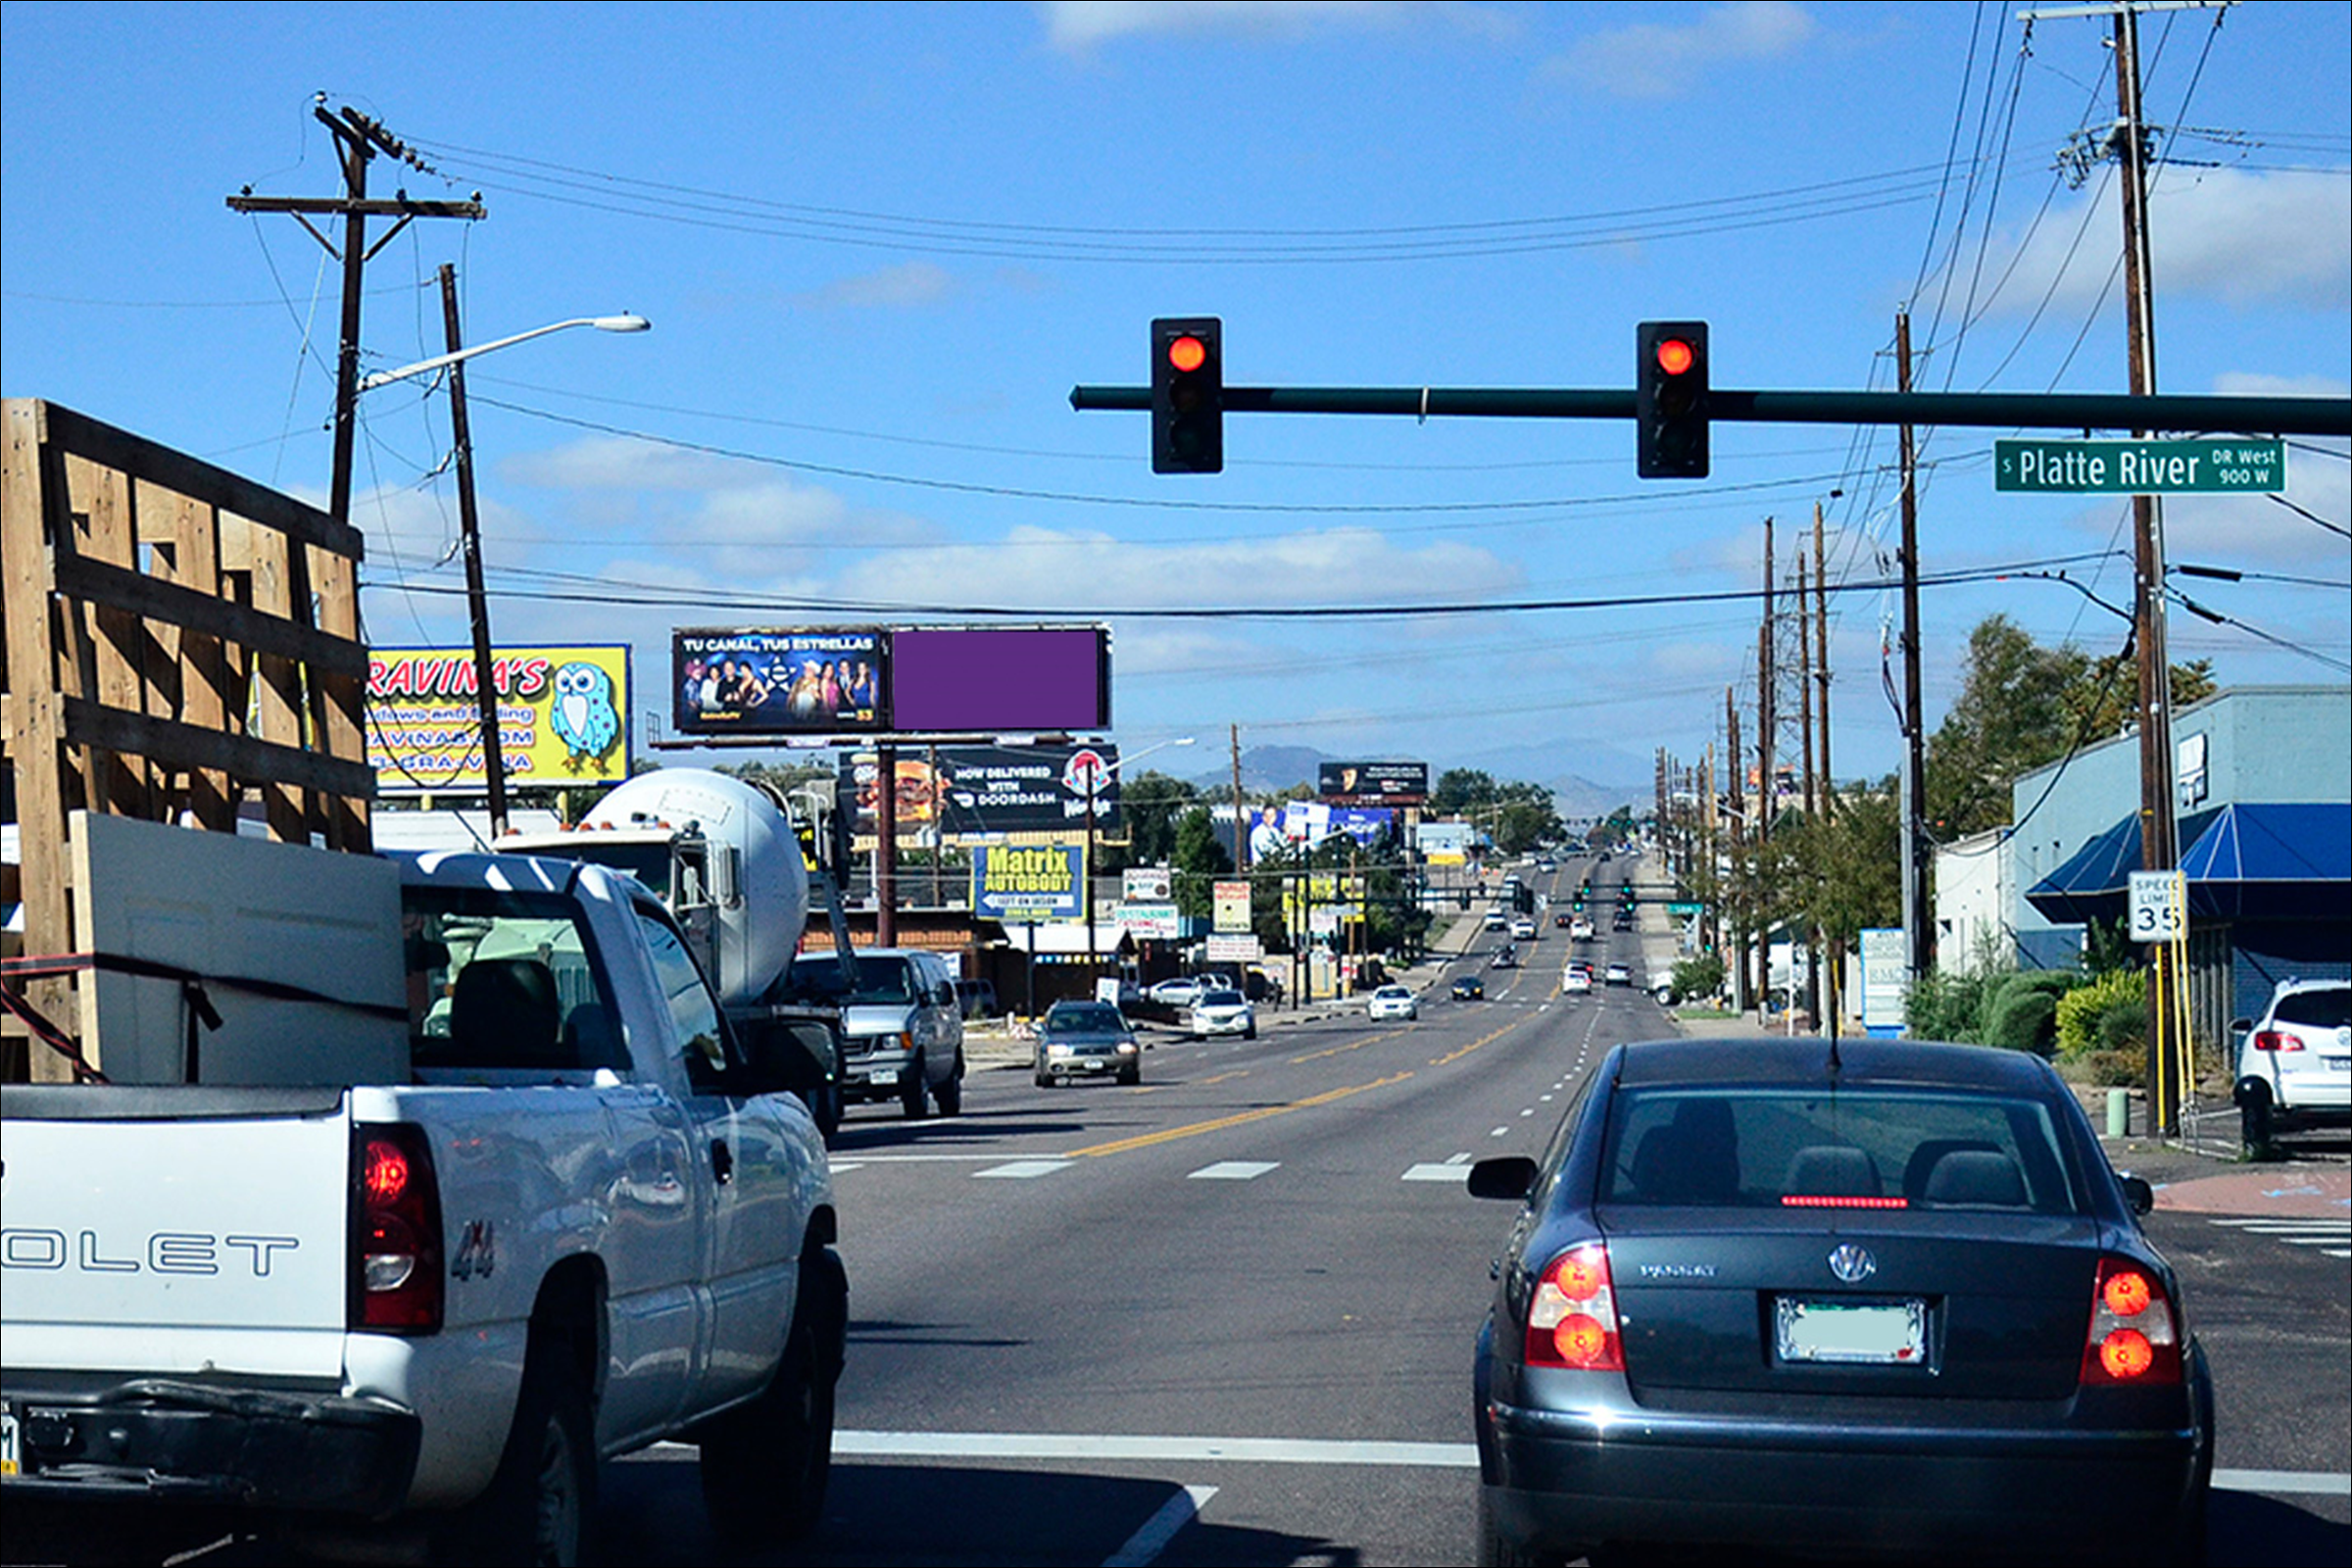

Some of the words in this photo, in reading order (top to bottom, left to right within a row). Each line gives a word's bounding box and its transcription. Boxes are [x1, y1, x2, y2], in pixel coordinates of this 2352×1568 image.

[2002, 458, 2012, 472] S
[2020, 449, 2105, 485] Platte
[2120, 448, 2199, 485] River
[2212, 450, 2232, 465] DR
[2238, 449, 2277, 464] West
[2220, 468, 2250, 484] 900
[2255, 468, 2270, 483] W
[683, 638, 703, 652] TU
[706, 638, 760, 653] CANAL,
[762, 638, 790, 651] TUS
[793, 637, 874, 651] ESTRELLAS
[365, 658, 550, 696] RAVINA'S
[432, 707, 467, 721] and
[956, 767, 985, 779] NOW
[987, 766, 1051, 779] DELIVERED
[987, 781, 1020, 792] WITH
[978, 792, 1056, 806] DOORDASH
[987, 846, 1068, 873] Matrix
[984, 872, 1073, 892] AUTOBODY
[2137, 906, 2181, 931] 35
